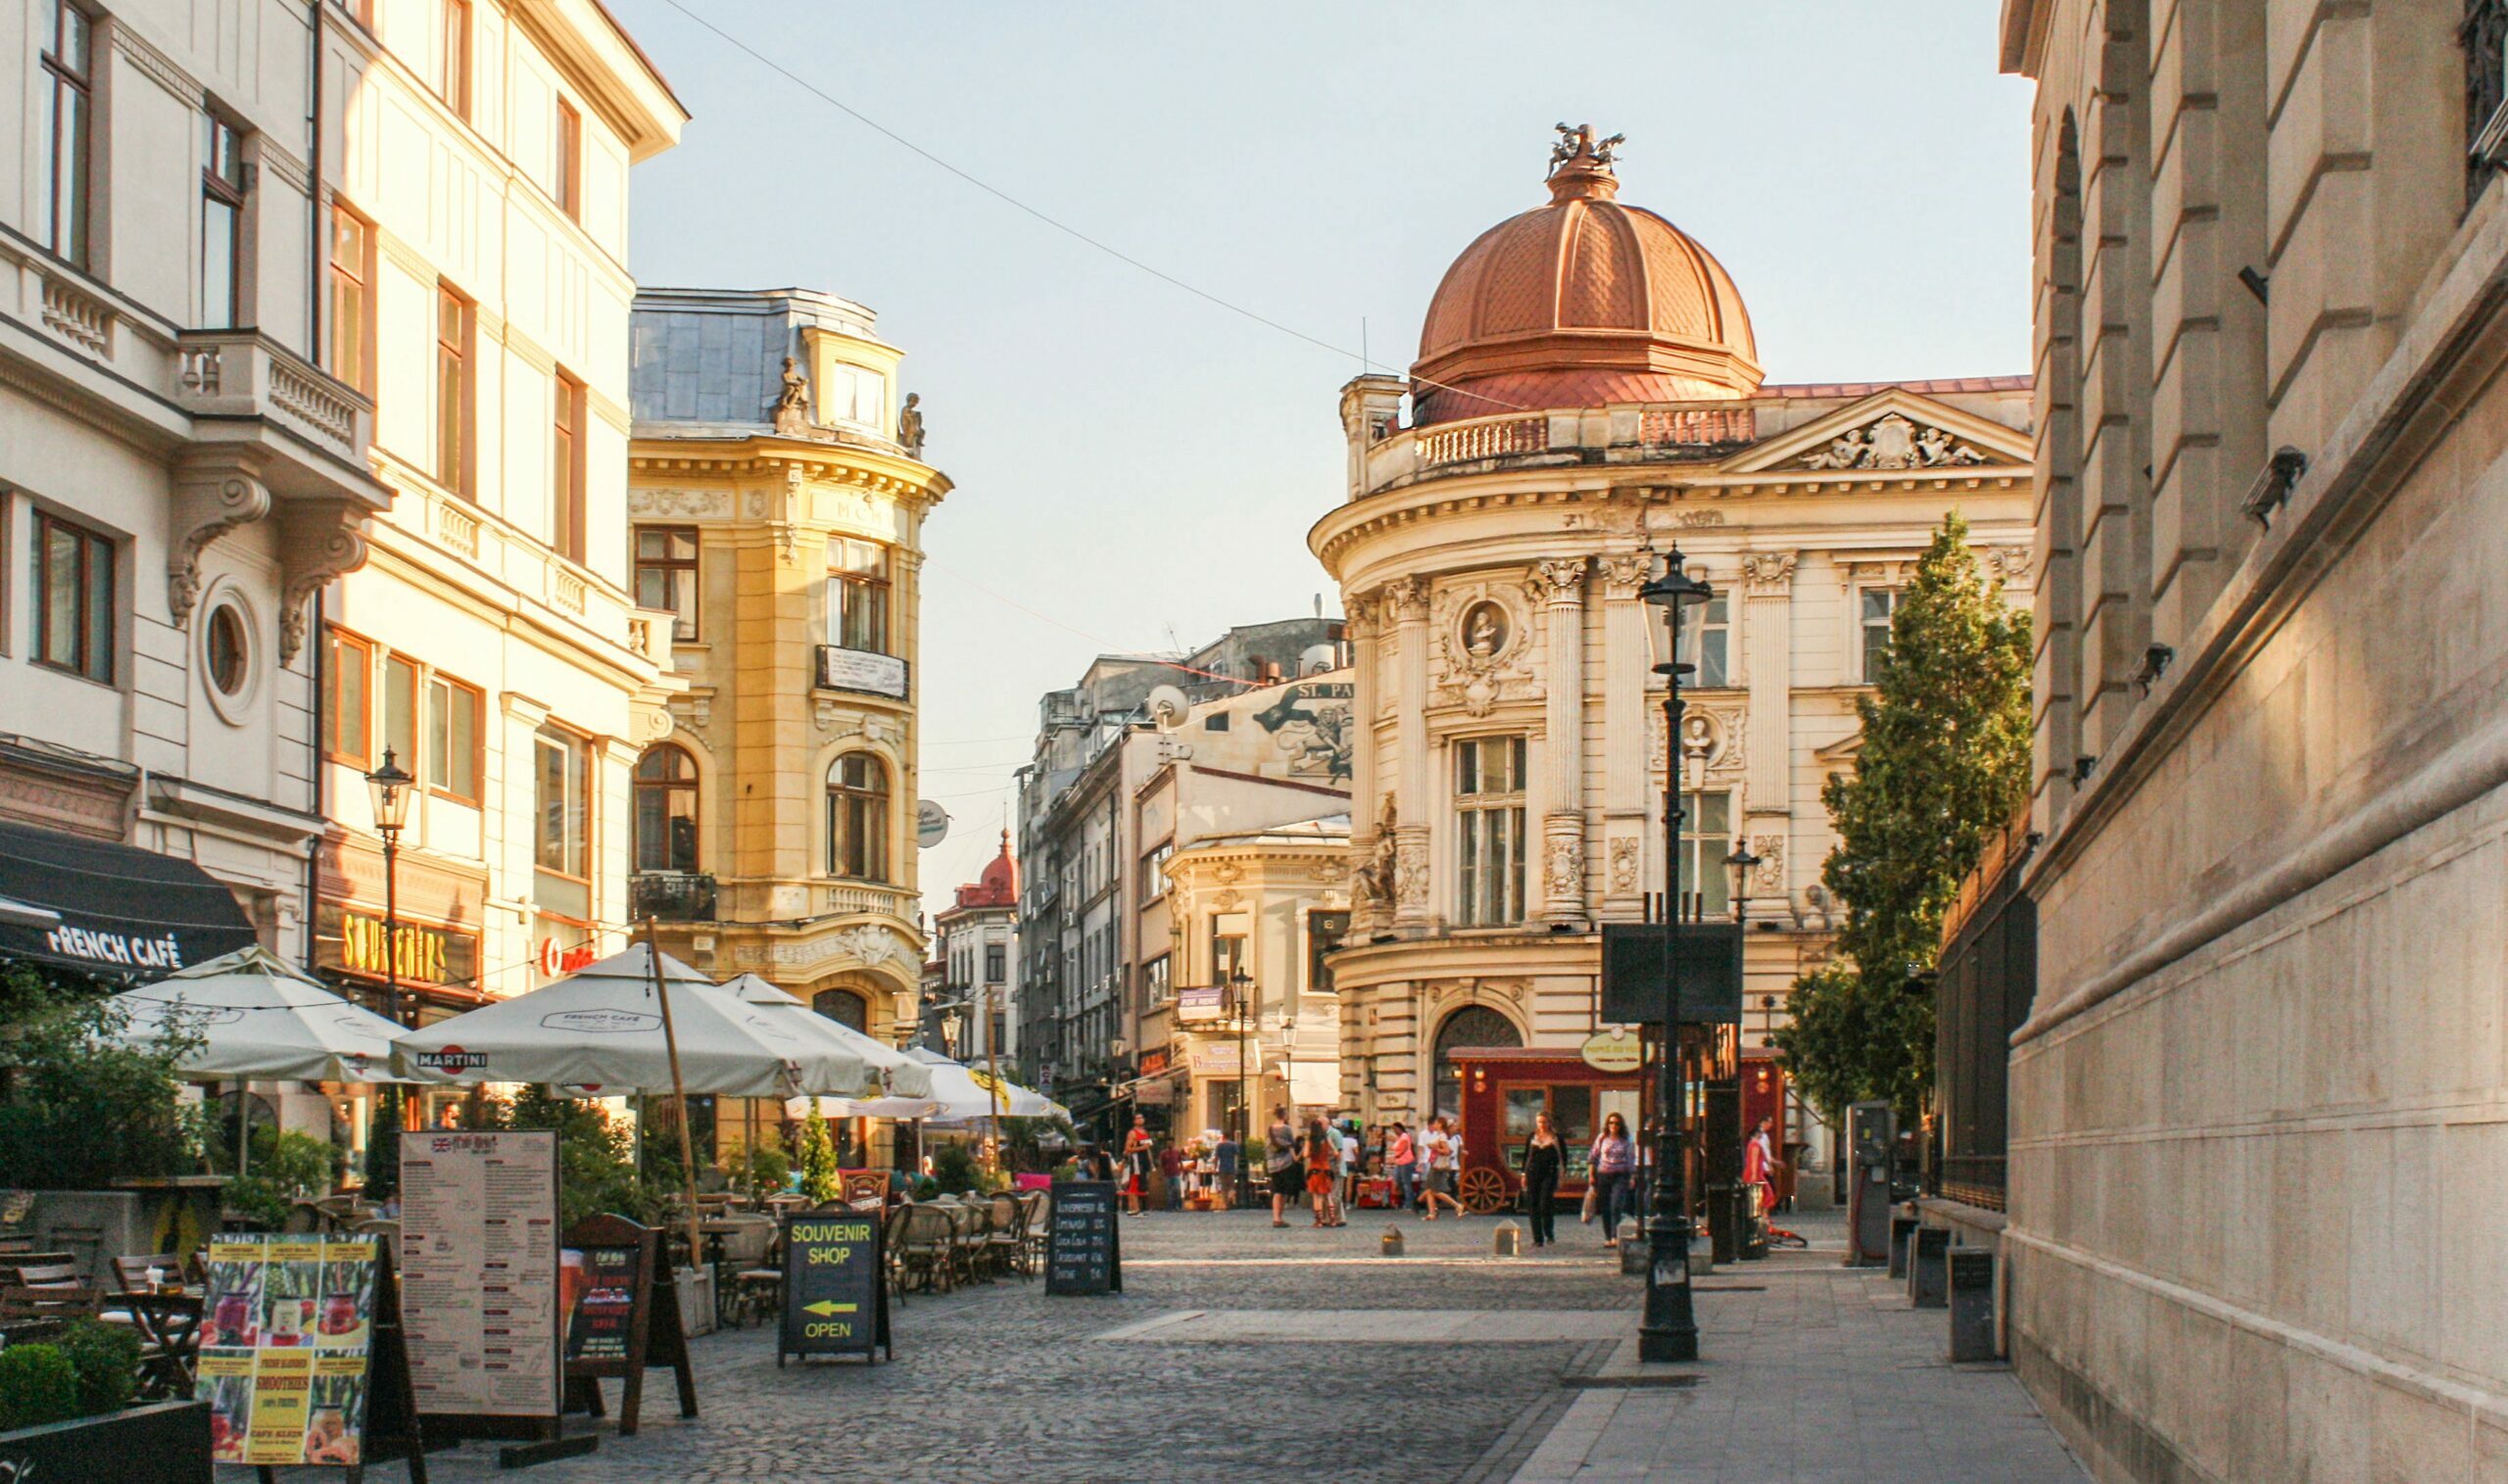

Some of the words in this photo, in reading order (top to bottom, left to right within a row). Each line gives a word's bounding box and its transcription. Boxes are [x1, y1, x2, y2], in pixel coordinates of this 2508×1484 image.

[1299, 684, 1322, 697] ST.
[47, 925, 133, 965] FRENCH
[131, 933, 184, 969] CAFÉ
[1181, 998, 1196, 1007] FOR
[1198, 997, 1218, 1006] RENT
[419, 1054, 487, 1067] MARTINI
[792, 1224, 871, 1242] SOUVENIR
[808, 1247, 850, 1265] SHOP
[805, 1322, 851, 1338] OPEN
[256, 1375, 310, 1391] SMOOTHIES
